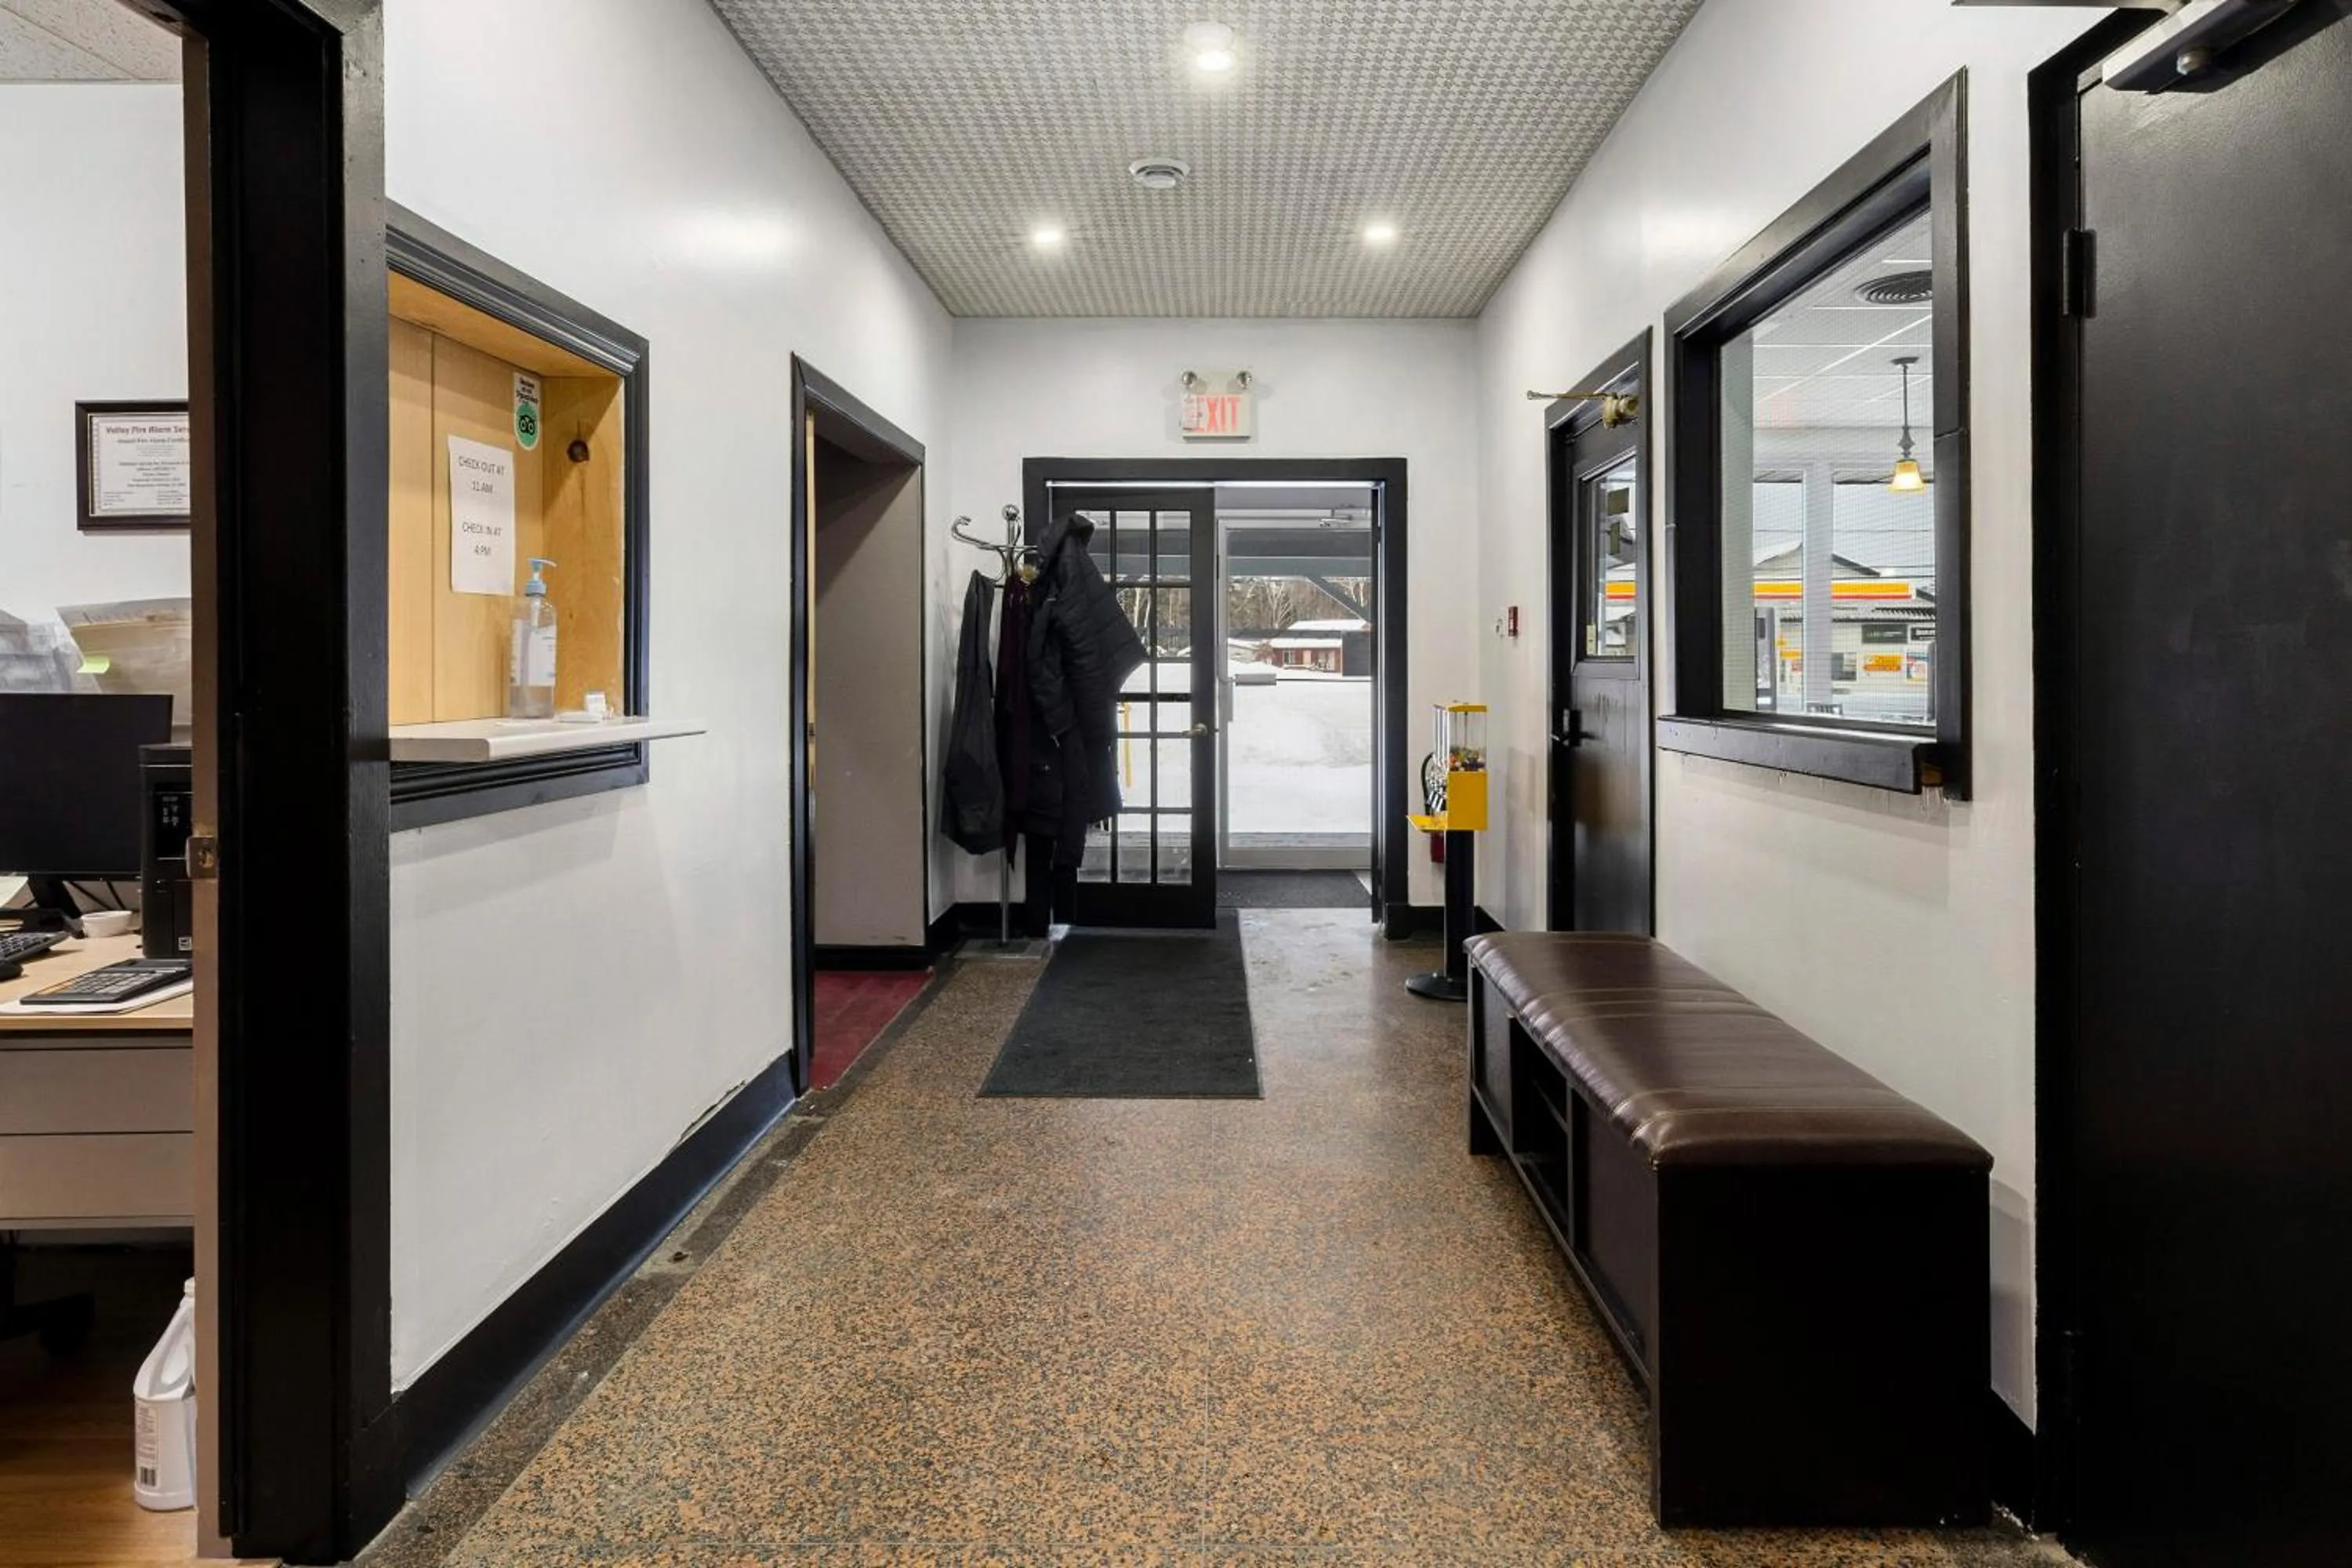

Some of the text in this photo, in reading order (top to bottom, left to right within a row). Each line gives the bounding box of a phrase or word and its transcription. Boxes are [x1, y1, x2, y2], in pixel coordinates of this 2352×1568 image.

[1195, 395, 1242, 432] EXIT
[458, 456, 505, 477] CHECK OUT AT
[472, 481, 493, 494] 11 AM
[462, 521, 503, 537] CHECK IN AT
